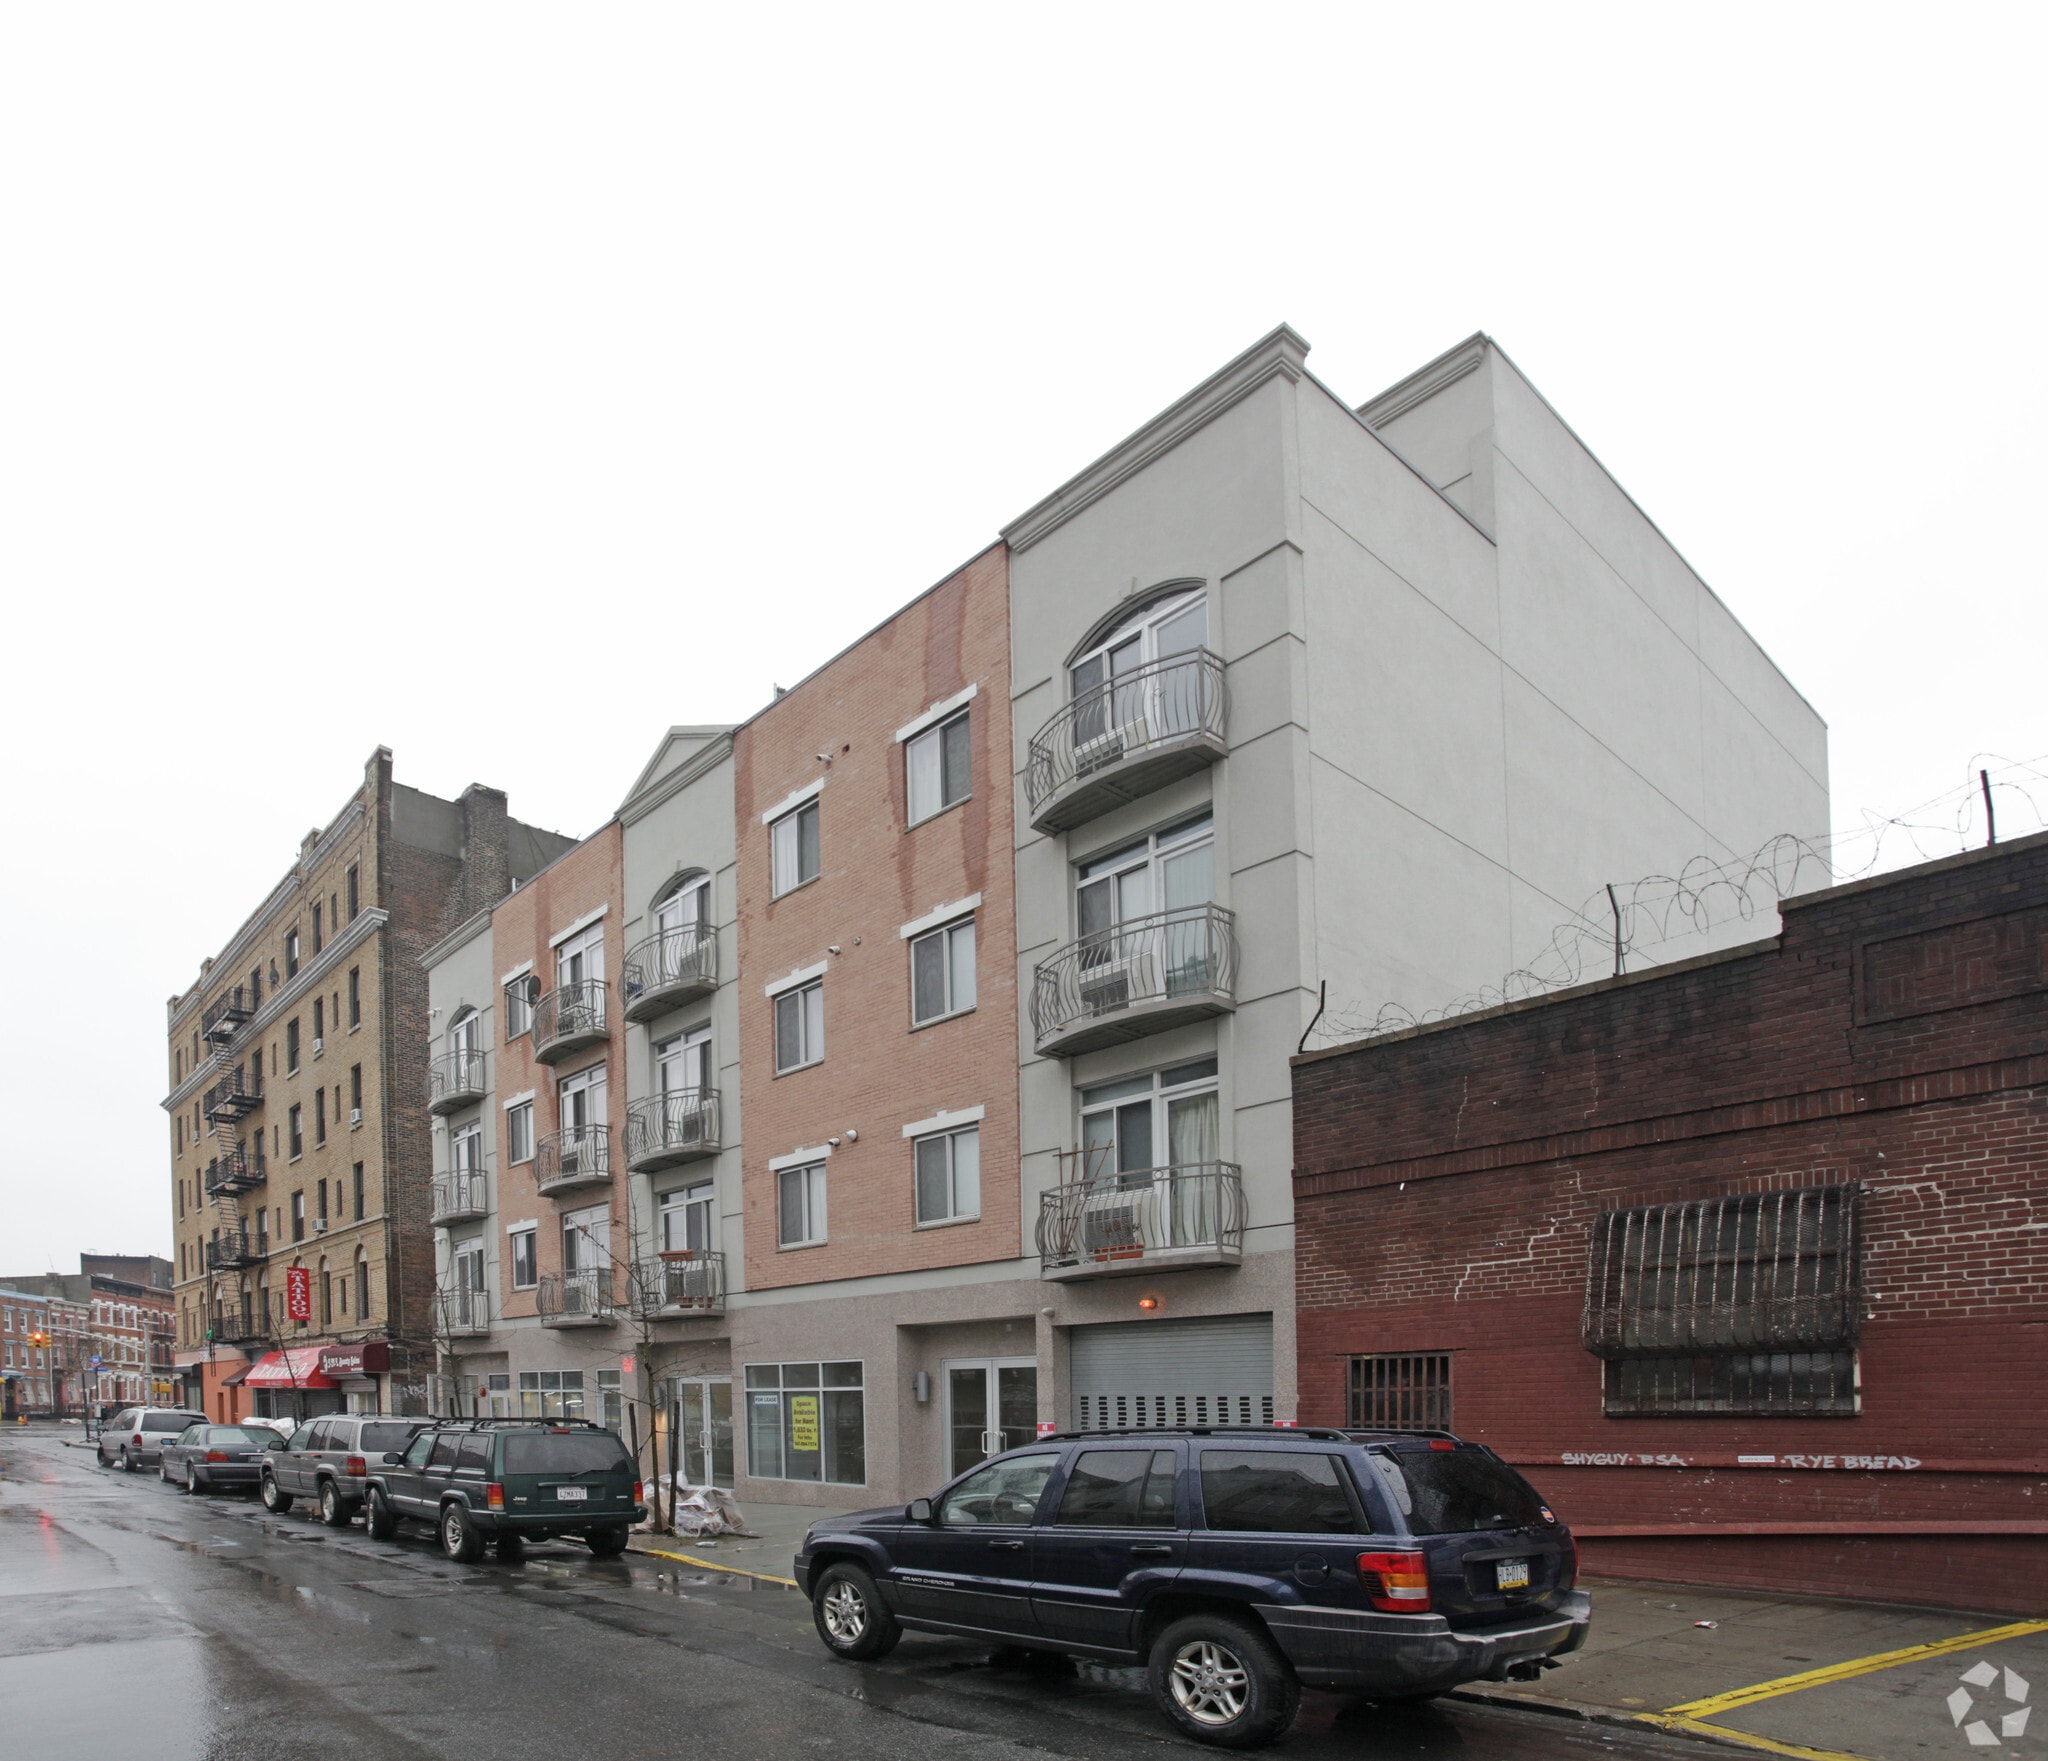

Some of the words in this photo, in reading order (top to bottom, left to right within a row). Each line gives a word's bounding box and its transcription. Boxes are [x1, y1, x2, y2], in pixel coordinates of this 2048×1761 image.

[291, 1275, 307, 1312] TATTOO
[257, 1363, 308, 1377] TATTOO
[1784, 1455, 1836, 1468] RYE
[1840, 1455, 1922, 1470] BREAD
